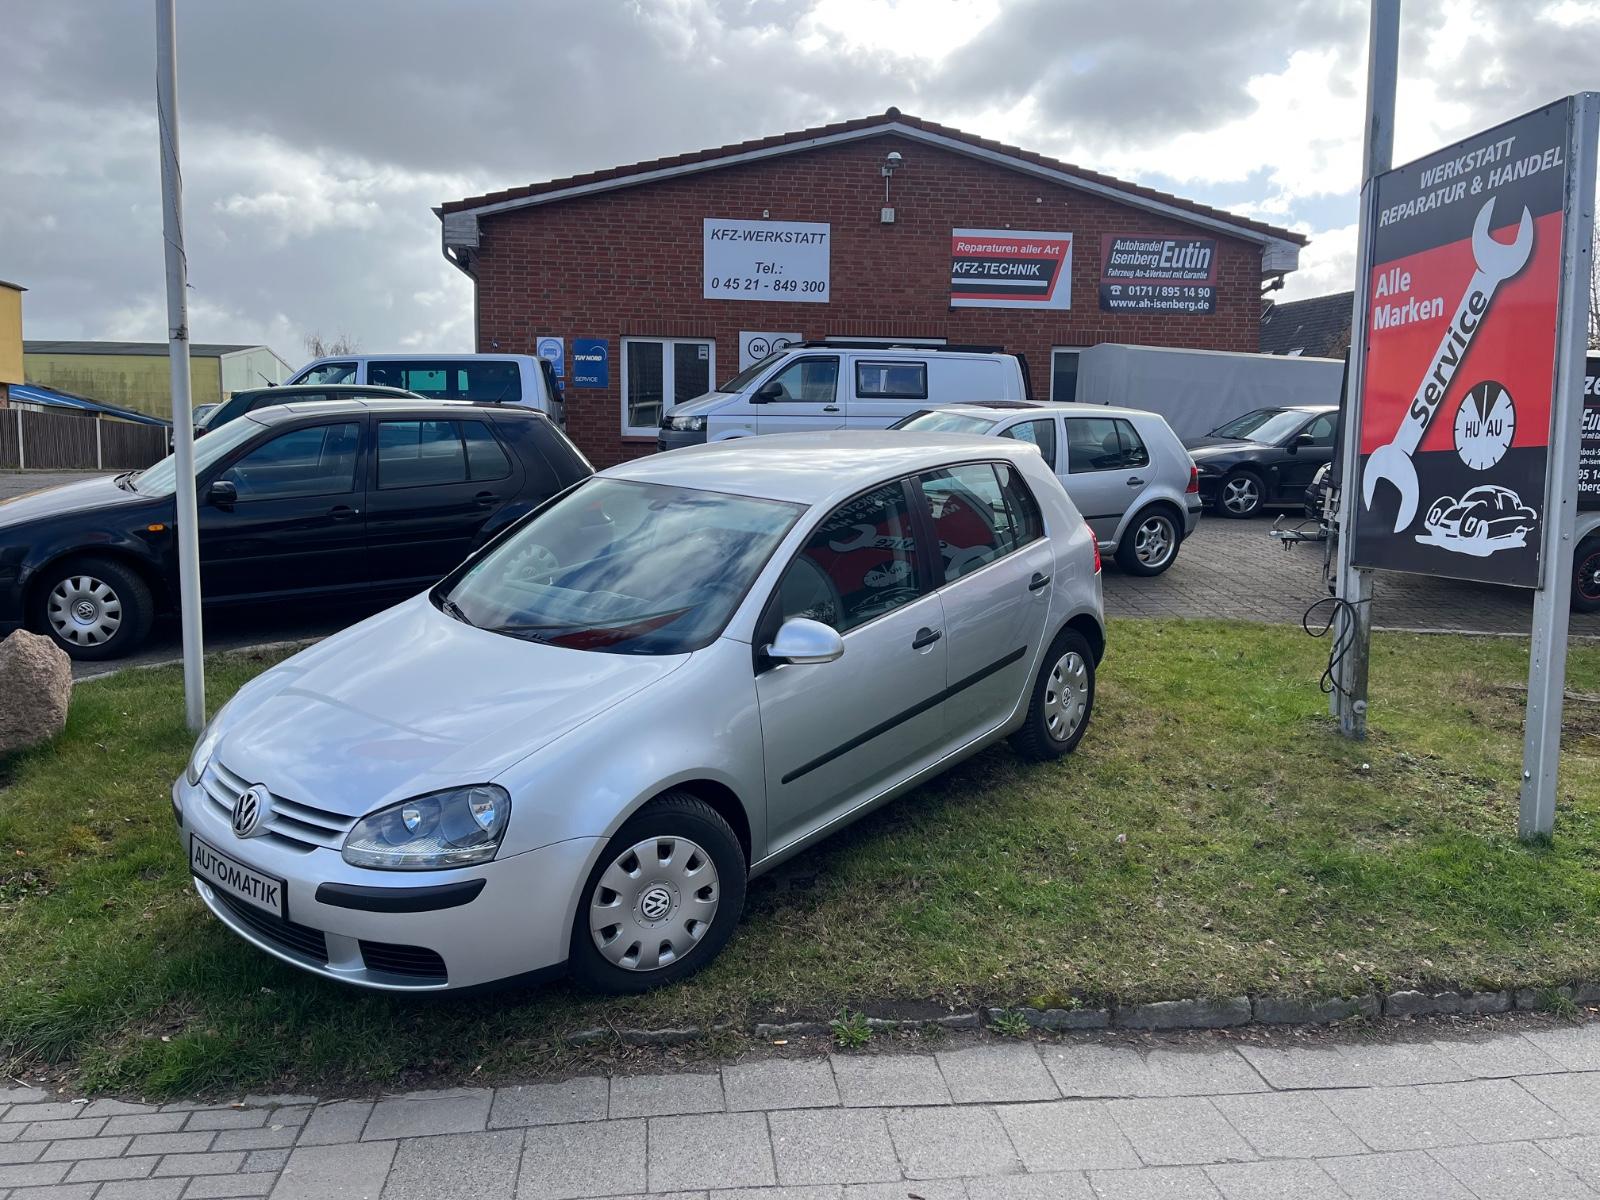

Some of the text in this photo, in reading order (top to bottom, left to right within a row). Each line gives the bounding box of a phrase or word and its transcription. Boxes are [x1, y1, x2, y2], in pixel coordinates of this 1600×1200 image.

[1420, 136, 1516, 190] WERKSTATT
[1379, 146, 1564, 228] REPARATUR & HANDEL
[711, 229, 826, 244] KFZ-WERKSTATT
[956, 242, 1059, 255] Reparaturen aller Art
[1114, 240, 1163, 252] Autohandel
[1111, 252, 1159, 268] Isenberg
[1160, 241, 1211, 269] Eutin
[755, 262, 783, 275] Tel.:
[952, 262, 1040, 276] KFZ-TECHNIK
[1108, 268, 1134, 278] Fahrzeug
[1172, 271, 1183, 279] mit
[1183, 270, 1208, 279] Garantie
[711, 277, 720, 289] 0
[723, 278, 740, 290] 45
[744, 279, 760, 290] 21
[773, 280, 797, 292] 849
[801, 280, 825, 292] 300
[1375, 267, 1411, 300] Alle
[1129, 286, 1210, 297] 0171 / 895 14 90
[1109, 299, 1209, 311] www.ah-isenberg.de
[1373, 296, 1444, 331] Marken
[753, 344, 766, 353] OK
[1410, 290, 1488, 429] Service
[1465, 419, 1502, 438] HU AU
[231, 788, 260, 837] VW
[195, 846, 278, 907] AUTOMATIK
